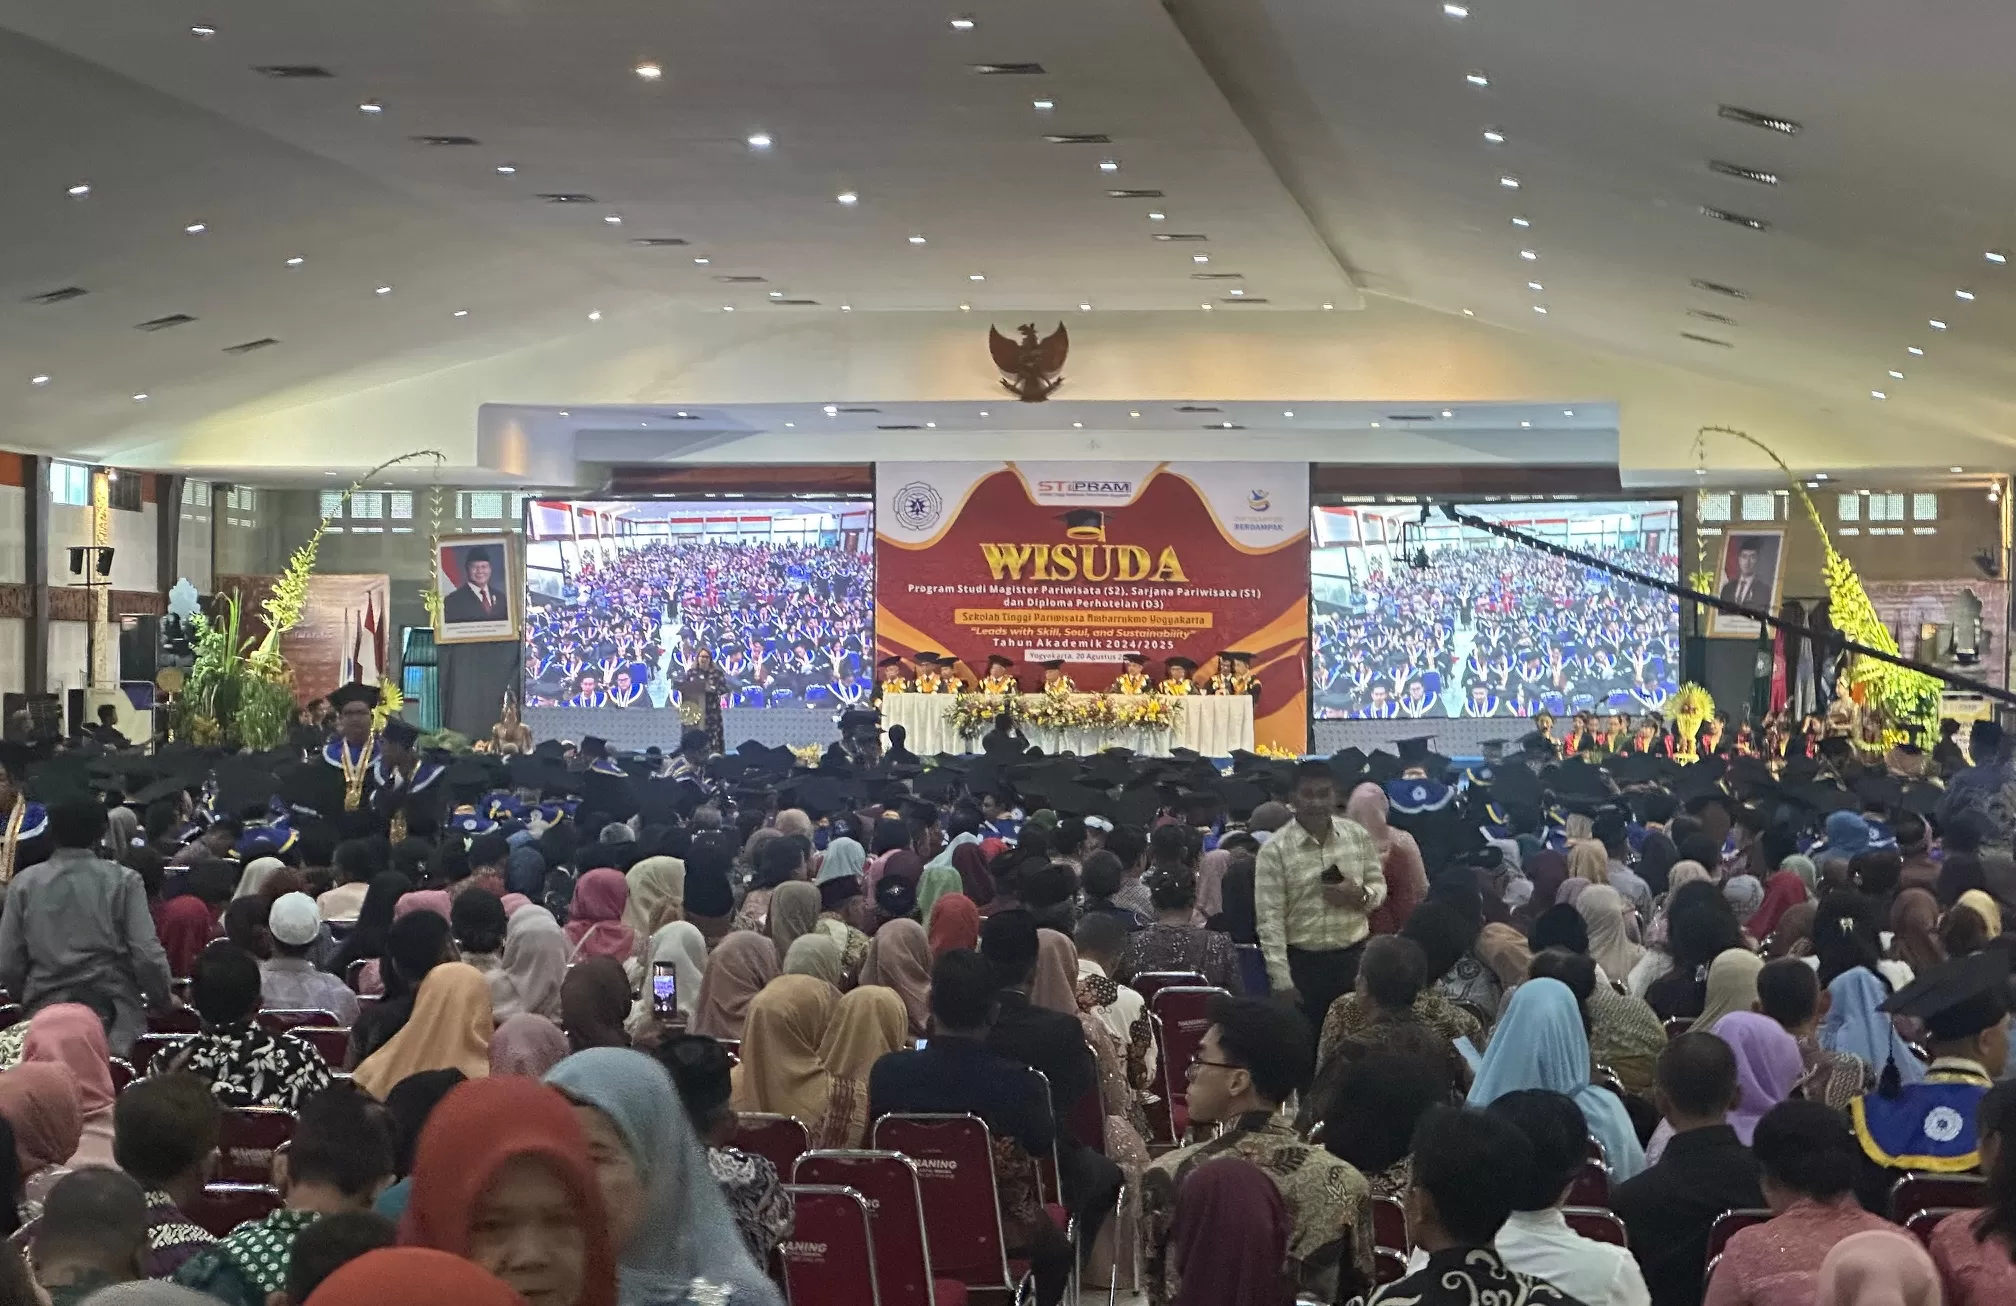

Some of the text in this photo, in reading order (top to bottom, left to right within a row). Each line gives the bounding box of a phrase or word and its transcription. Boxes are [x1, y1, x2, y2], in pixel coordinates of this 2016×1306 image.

[980, 543, 1189, 582] WISUDA
[908, 584, 954, 595] Program
[957, 584, 986, 593] Studi
[990, 585, 1038, 596] Magister
[1041, 586, 1100, 595] Pariwisata
[1131, 587, 1173, 598] Sarjana
[1177, 587, 1237, 597] Pariwisata
[1240, 588, 1261, 599] (S1)
[1004, 597, 1164, 609] dan Diploma Perhotelan (D3)
[963, 612, 1205, 626] Sekolah Tinggi Pariwisata Ambarrukmo Yogyakarta
[1010, 626, 1034, 636] with
[1036, 627, 1062, 637] Skill,
[1065, 628, 1090, 637] Soul,
[1093, 628, 1114, 637] and
[993, 637, 1174, 650] Tahun Akademik 2024/2025
[1076, 652, 1085, 660] 20
[1086, 653, 1116, 661] Agustus
